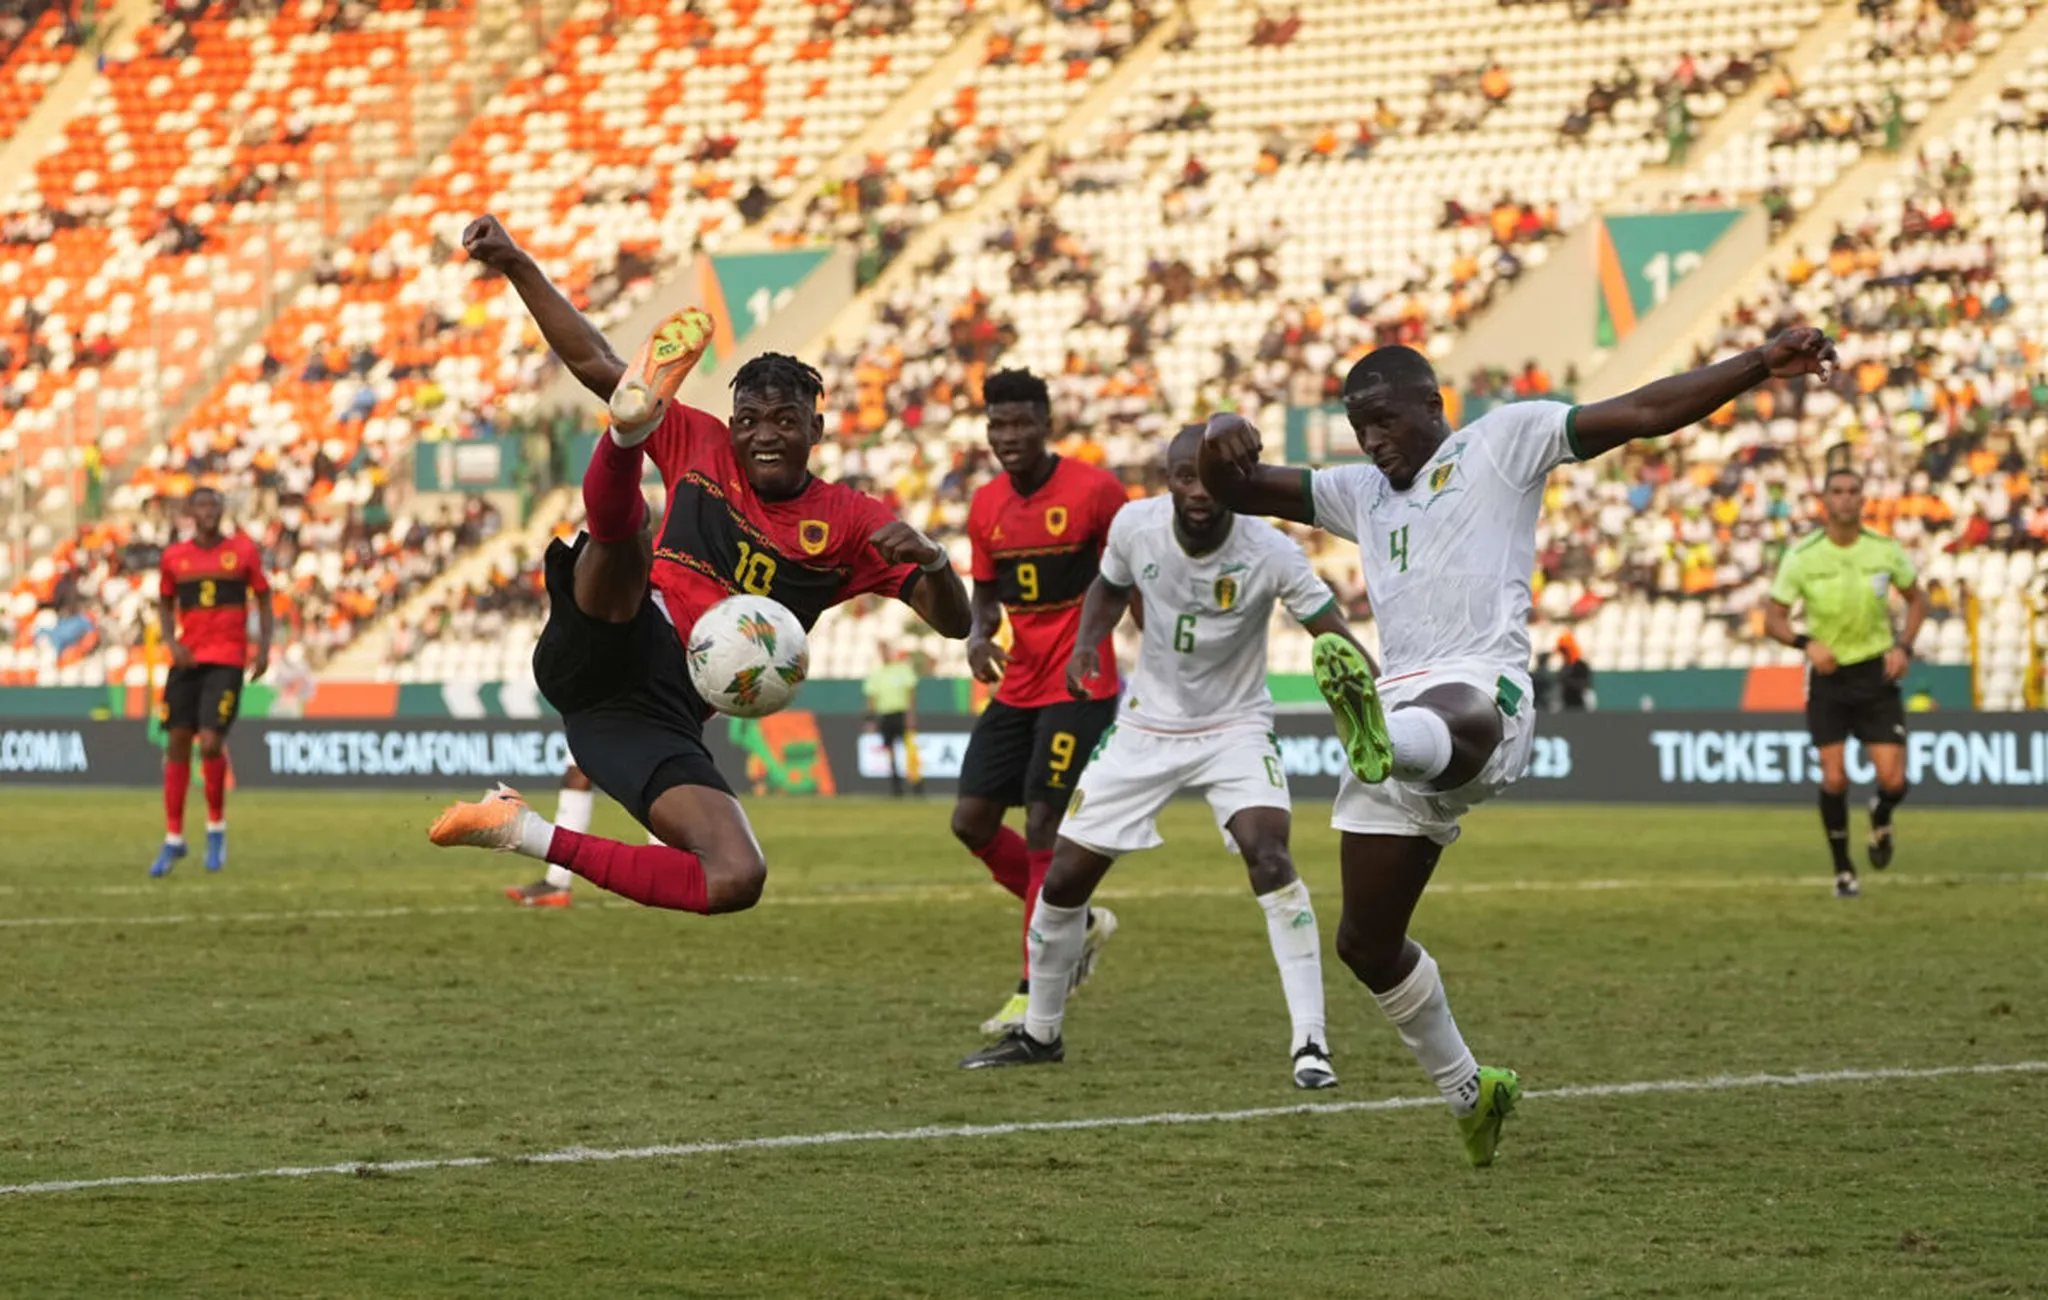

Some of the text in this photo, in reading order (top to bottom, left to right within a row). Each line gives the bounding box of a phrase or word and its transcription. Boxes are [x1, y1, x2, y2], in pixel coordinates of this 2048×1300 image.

[1390, 524, 1409, 573] 4
[733, 541, 777, 597] 10
[1017, 563, 1039, 600] 9
[200, 579, 217, 607] 2
[1174, 613, 1197, 654] 6
[1050, 731, 1076, 771] 9
[1263, 755, 1285, 789] 6
